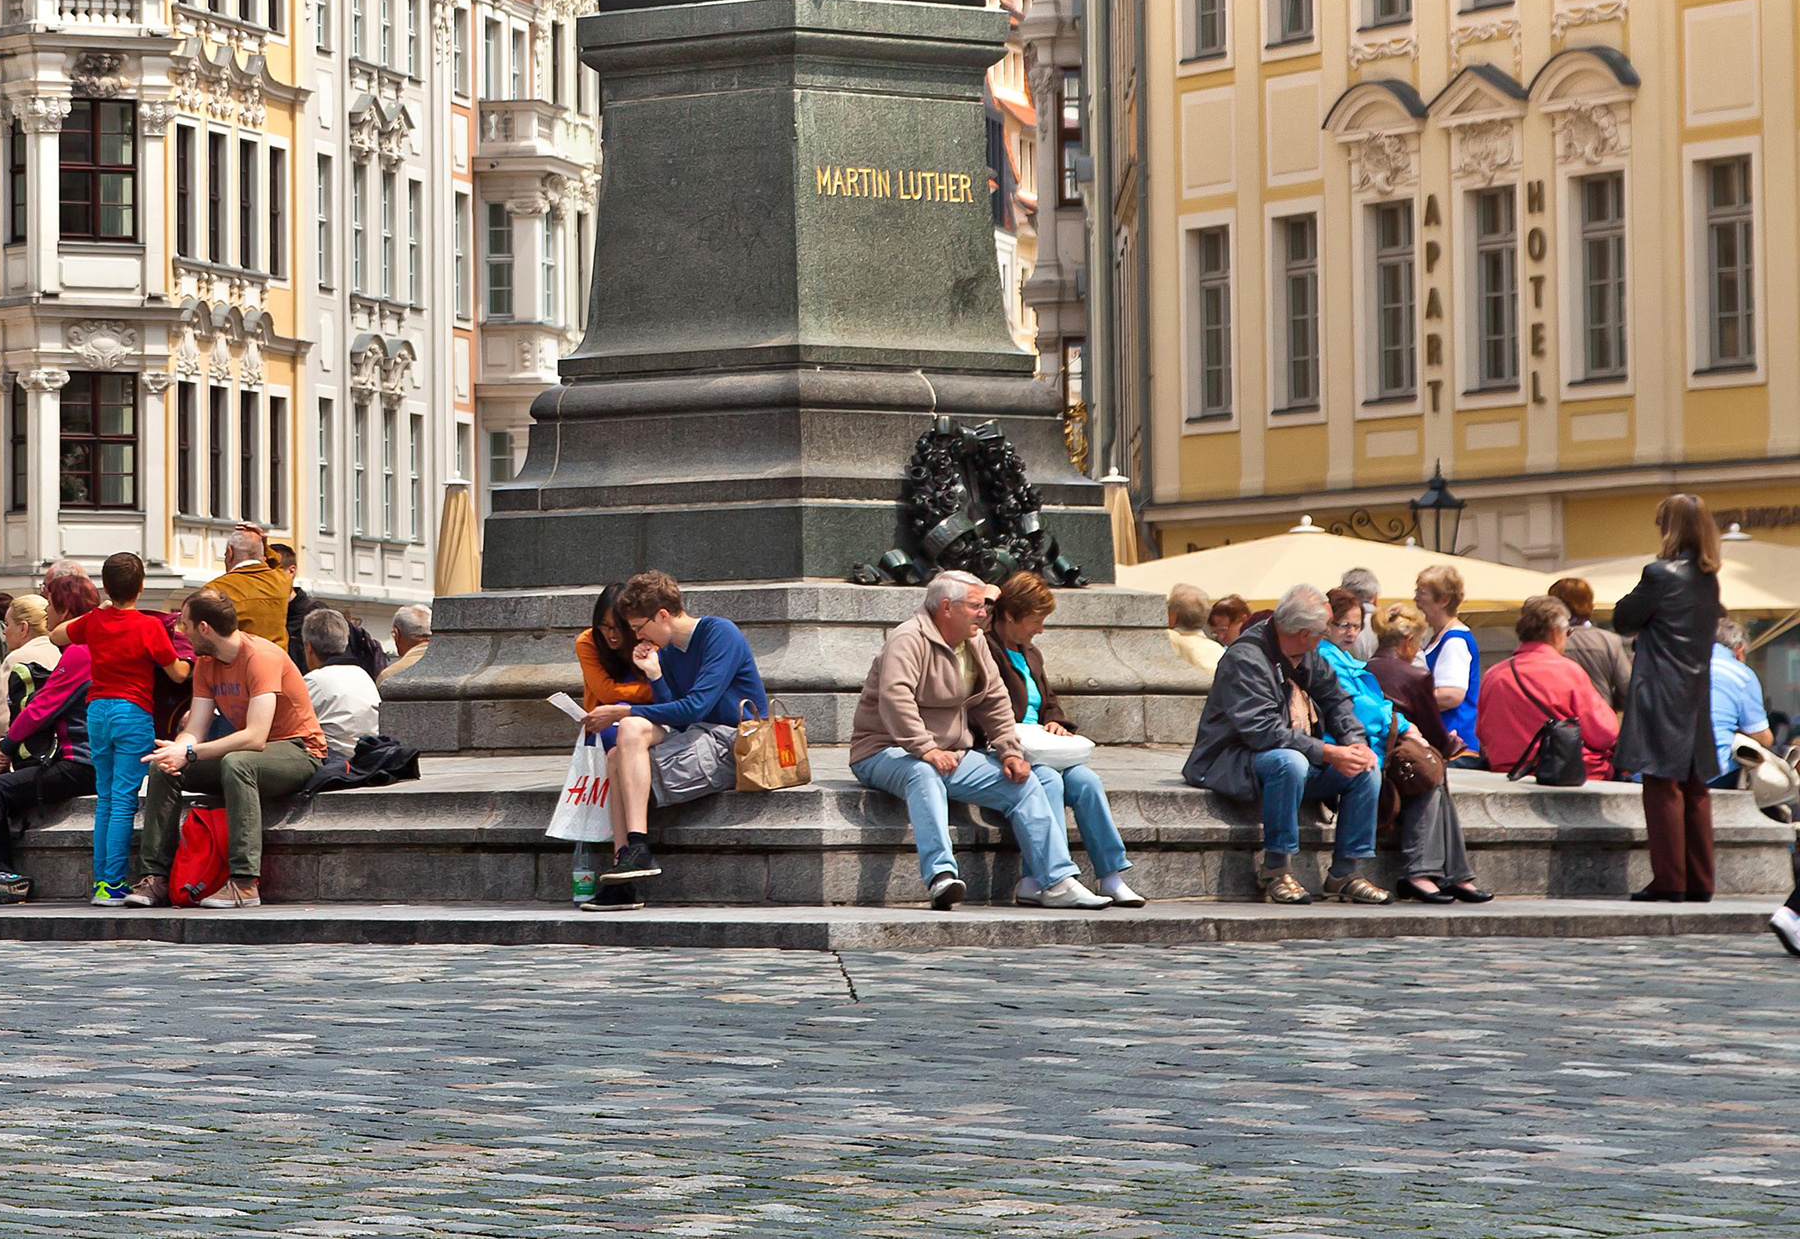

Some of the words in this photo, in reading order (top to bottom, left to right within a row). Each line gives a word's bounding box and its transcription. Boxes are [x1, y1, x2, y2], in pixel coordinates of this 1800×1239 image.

[816, 165, 891, 198] MARTIN
[899, 170, 974, 204] LUTHER
[1424, 193, 1443, 414] APART
[1527, 179, 1548, 405] HOTEL
[565, 775, 610, 808] H&M
